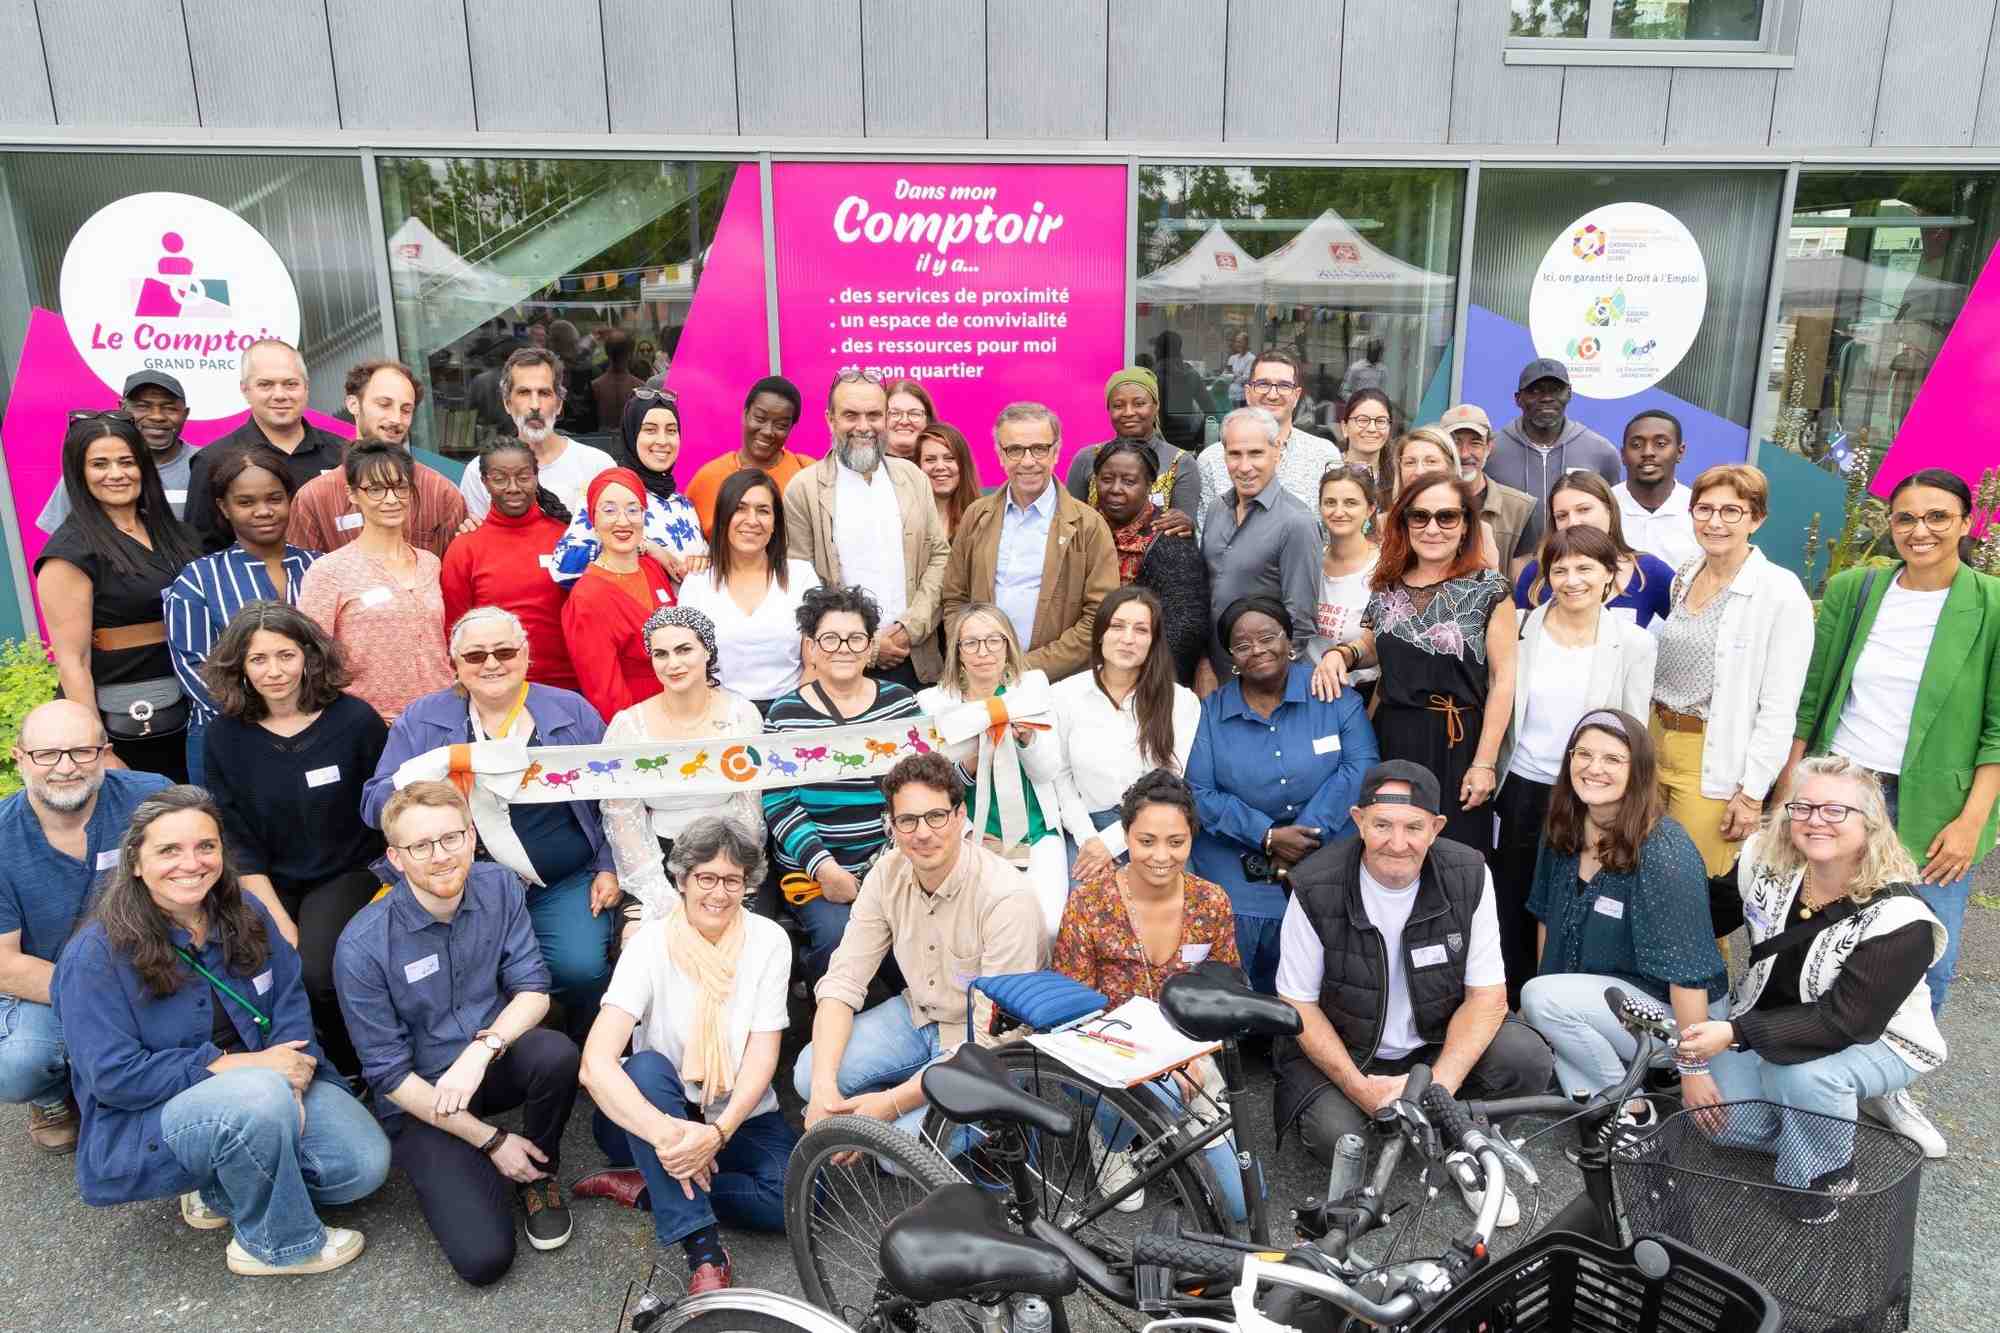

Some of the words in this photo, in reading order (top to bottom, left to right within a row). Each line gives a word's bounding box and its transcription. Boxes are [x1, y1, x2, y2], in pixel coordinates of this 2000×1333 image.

[895, 178, 945, 200] Dans
[950, 184, 997, 200] mon
[833, 195, 1064, 254] Comptoir
[915, 252, 931, 272] il
[932, 258, 947, 277] y
[951, 258, 980, 272] a...
[1559, 275, 1572, 283] on
[1573, 272, 1612, 284] garantit
[1615, 272, 1624, 282] le
[1626, 273, 1651, 283] Droit
[840, 288, 872, 303] des
[877, 288, 950, 303] services
[955, 288, 977, 303] de
[982, 288, 1069, 306] proximité
[841, 315, 864, 328] un
[869, 315, 931, 331] espace
[936, 312, 958, 328] de
[963, 312, 1067, 328] convivialité
[91, 323, 123, 350] Le
[134, 323, 281, 357] Comptoi
[841, 338, 873, 353] des
[878, 341, 972, 353] ressources
[977, 340, 1018, 356] pour
[1023, 337, 1057, 353] moi
[143, 358, 195, 369] GRAND
[199, 359, 236, 369] PARC
[910, 362, 984, 381] quartier
